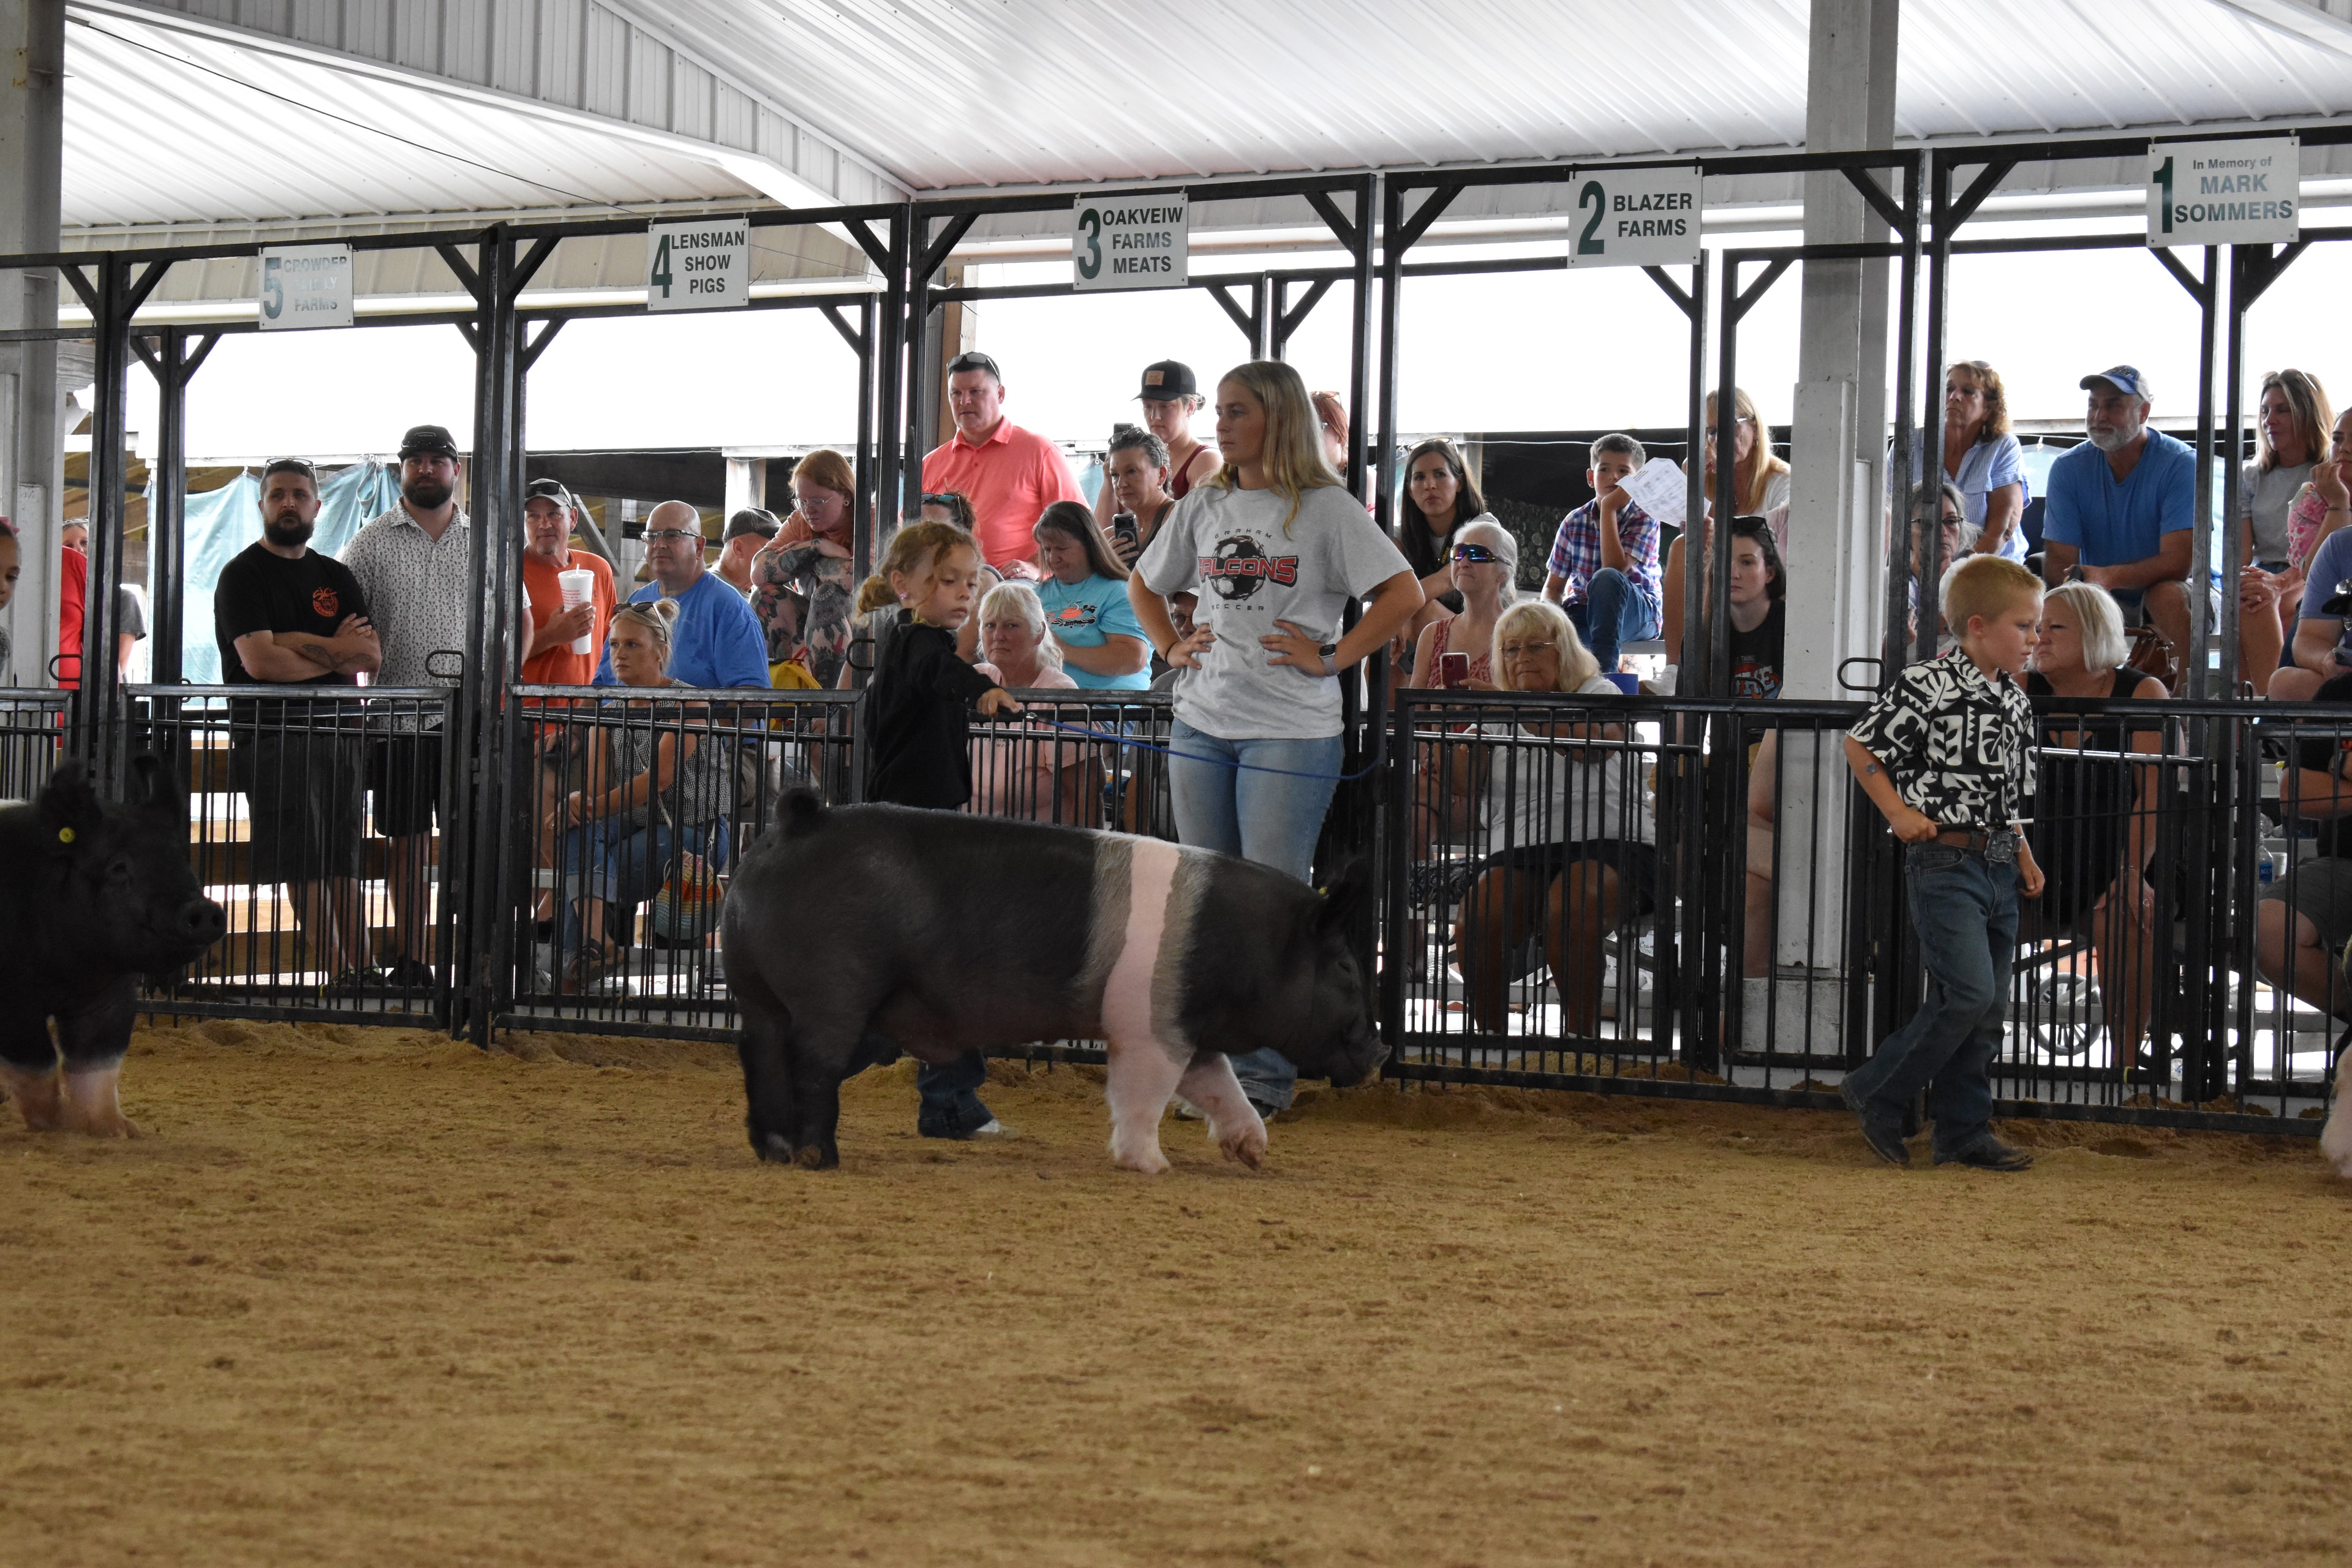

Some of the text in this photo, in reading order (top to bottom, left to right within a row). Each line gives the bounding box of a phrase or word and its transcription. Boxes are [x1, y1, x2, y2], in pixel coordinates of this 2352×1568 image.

[2193, 156, 2272, 170] In Memory of
[2201, 173, 2268, 194] MARK
[1613, 193, 1692, 212] BLAZER
[2152, 156, 2173, 233] 1
[1102, 207, 1183, 225] OAKVEIW
[1577, 180, 1605, 255] 2
[2174, 200, 2293, 223] SOMMERS
[1618, 219, 1686, 237] FARMS
[671, 230, 745, 249] LENSMAN
[1078, 208, 1101, 279] 3
[1112, 232, 1172, 250] FARMS
[284, 256, 347, 273] CROWDER
[651, 235, 673, 298] 4
[685, 254, 731, 272] SHOW
[1114, 255, 1172, 273] MEATS
[263, 257, 284, 320] 5
[690, 277, 725, 294] PIGS
[295, 297, 337, 312] FARMS
[1215, 529, 1272, 539] GRAHAM
